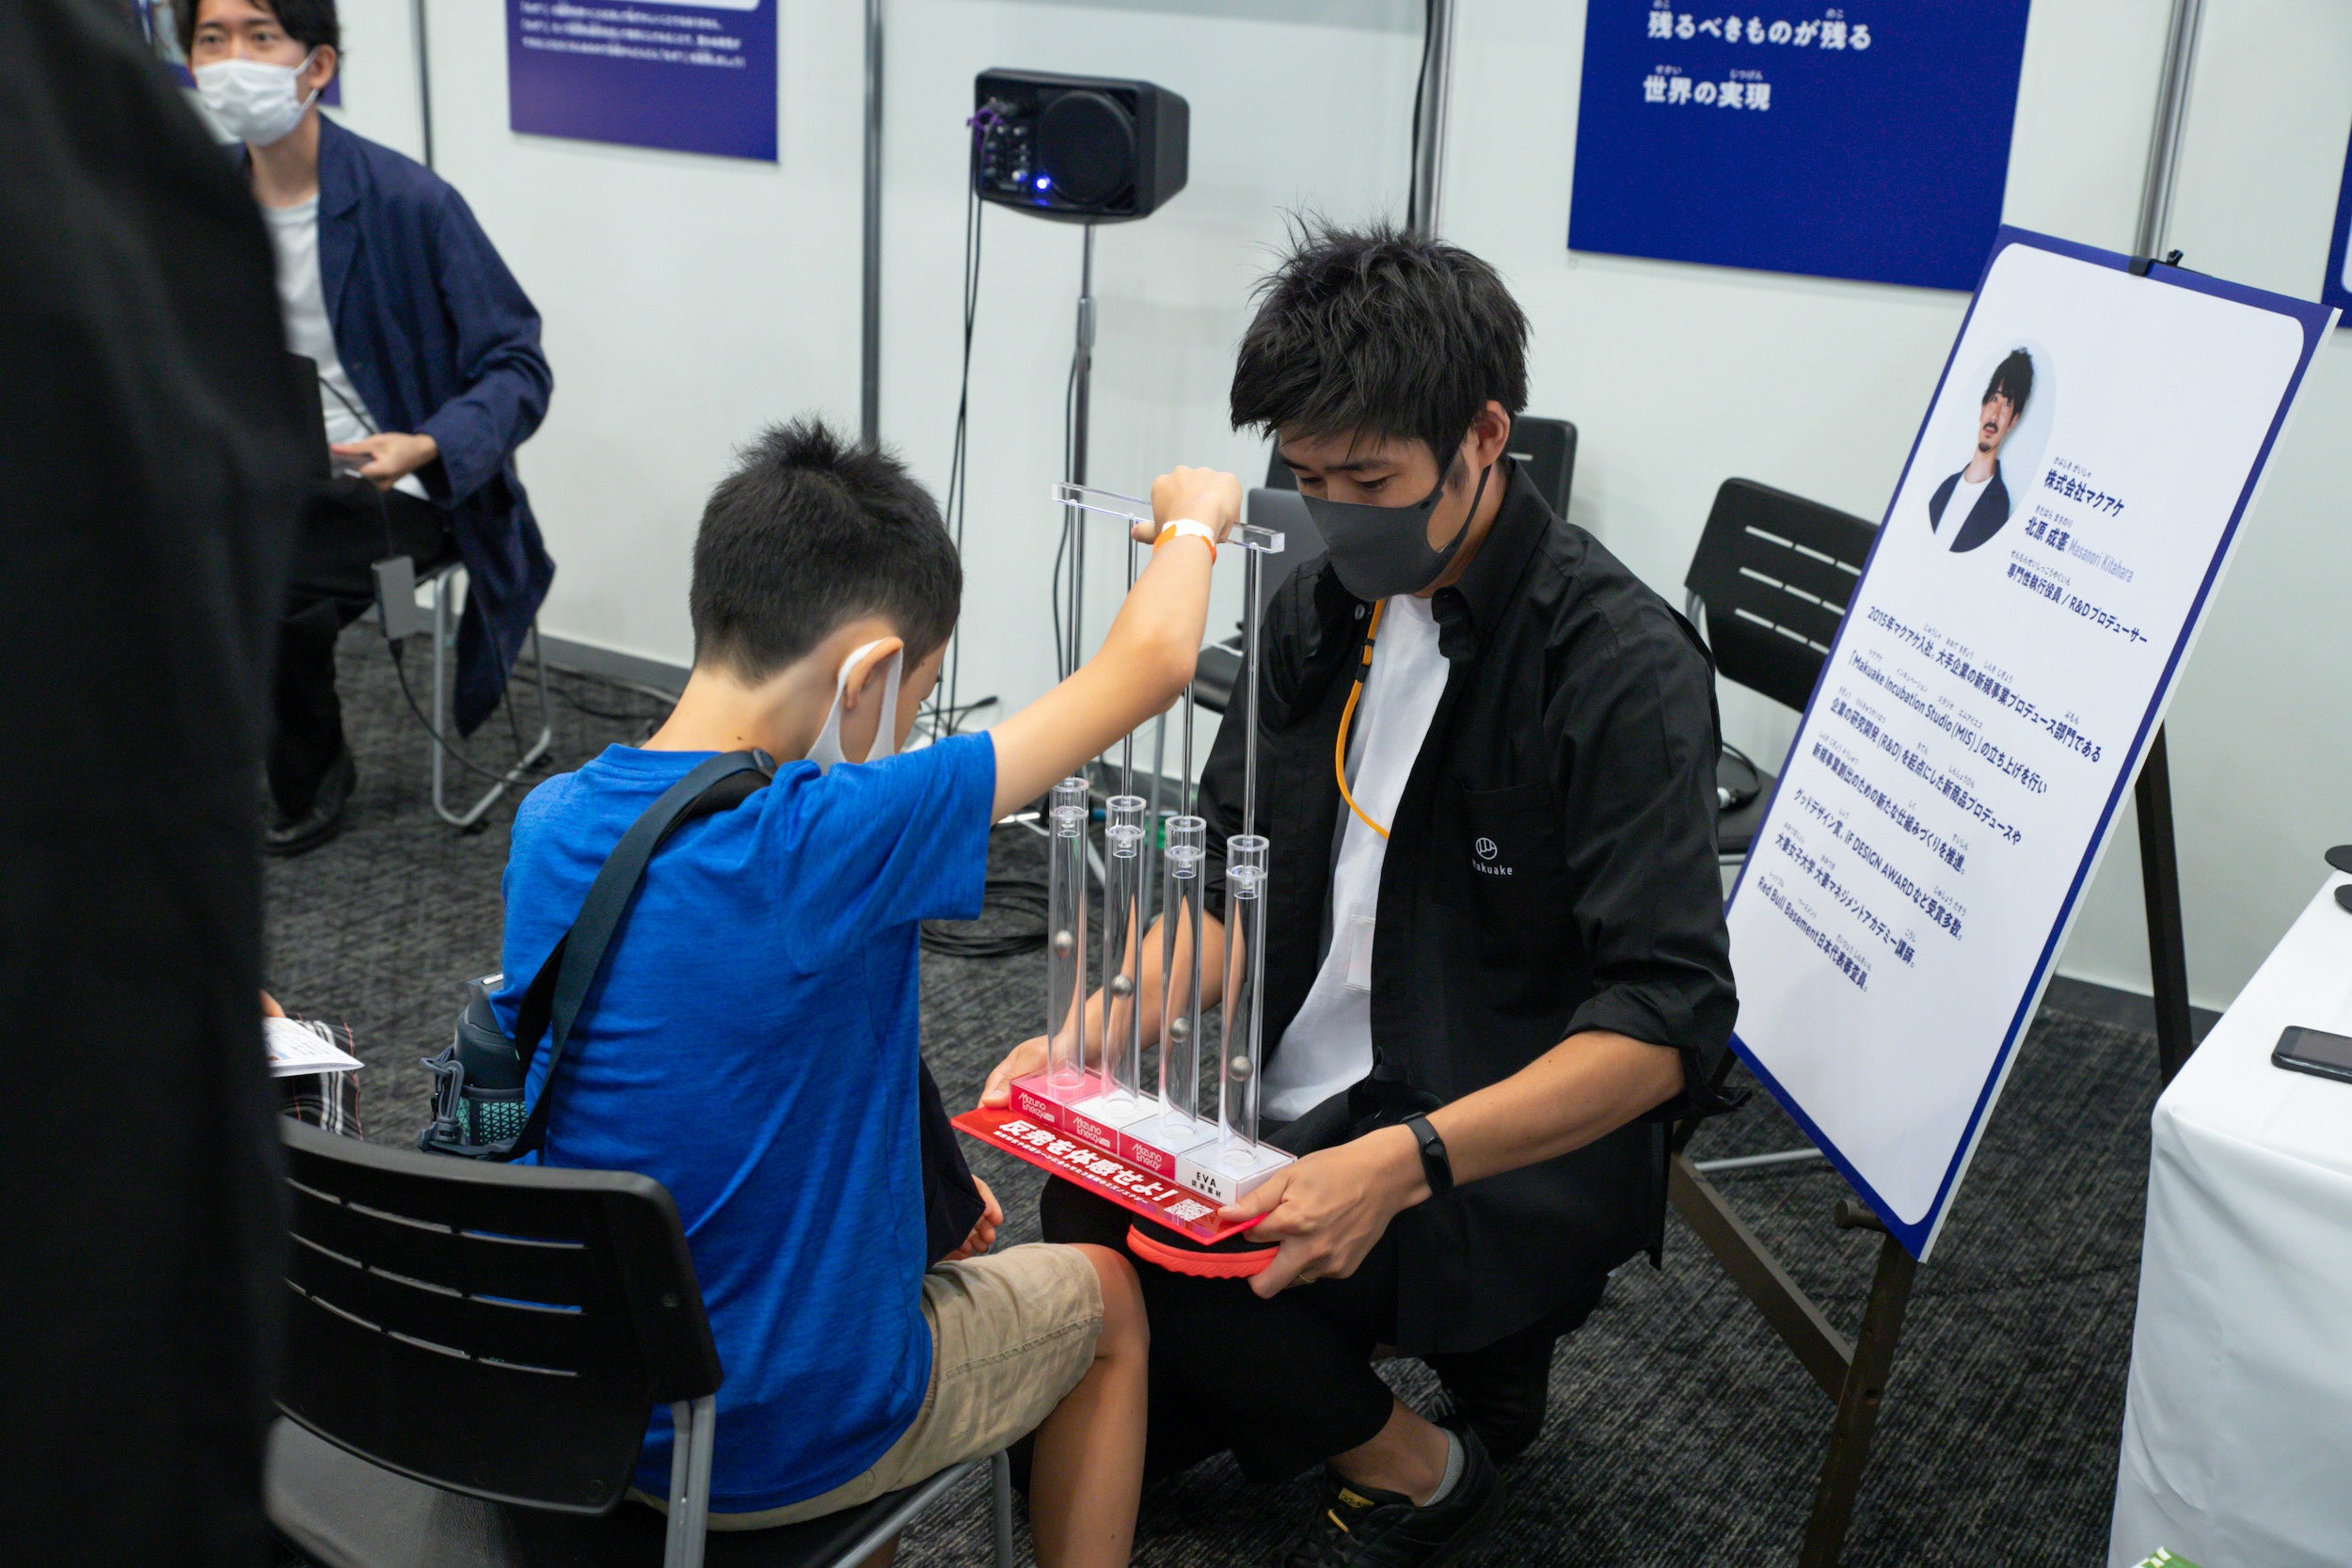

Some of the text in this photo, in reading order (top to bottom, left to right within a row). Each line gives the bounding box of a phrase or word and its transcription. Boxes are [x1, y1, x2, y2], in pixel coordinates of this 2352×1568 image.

[1647, 10, 1871, 50] 残るべきものが残る
[1643, 75, 1772, 111] 世界の実現
[2044, 468, 2124, 517] 株式会社マクアケ
[2025, 516, 2134, 583] 北原 成憲 Masanori Kitahara
[2007, 562, 2062, 604] 専門性執行役員
[1883, 676, 1926, 714] Incubation
[1925, 705, 1952, 732] Studio
[1852, 837, 1883, 870] DESIGN
[1757, 876, 1773, 896] Red
[1771, 888, 1787, 911] Bull
[1018, 1092, 1046, 1110] Mizuno
[1073, 1117, 1102, 1135] Mizuno
[999, 1119, 1179, 1201] 反発を体感せよ!
[1132, 1143, 1162, 1162] Mizuno
[1196, 1171, 1216, 1188] EVA
